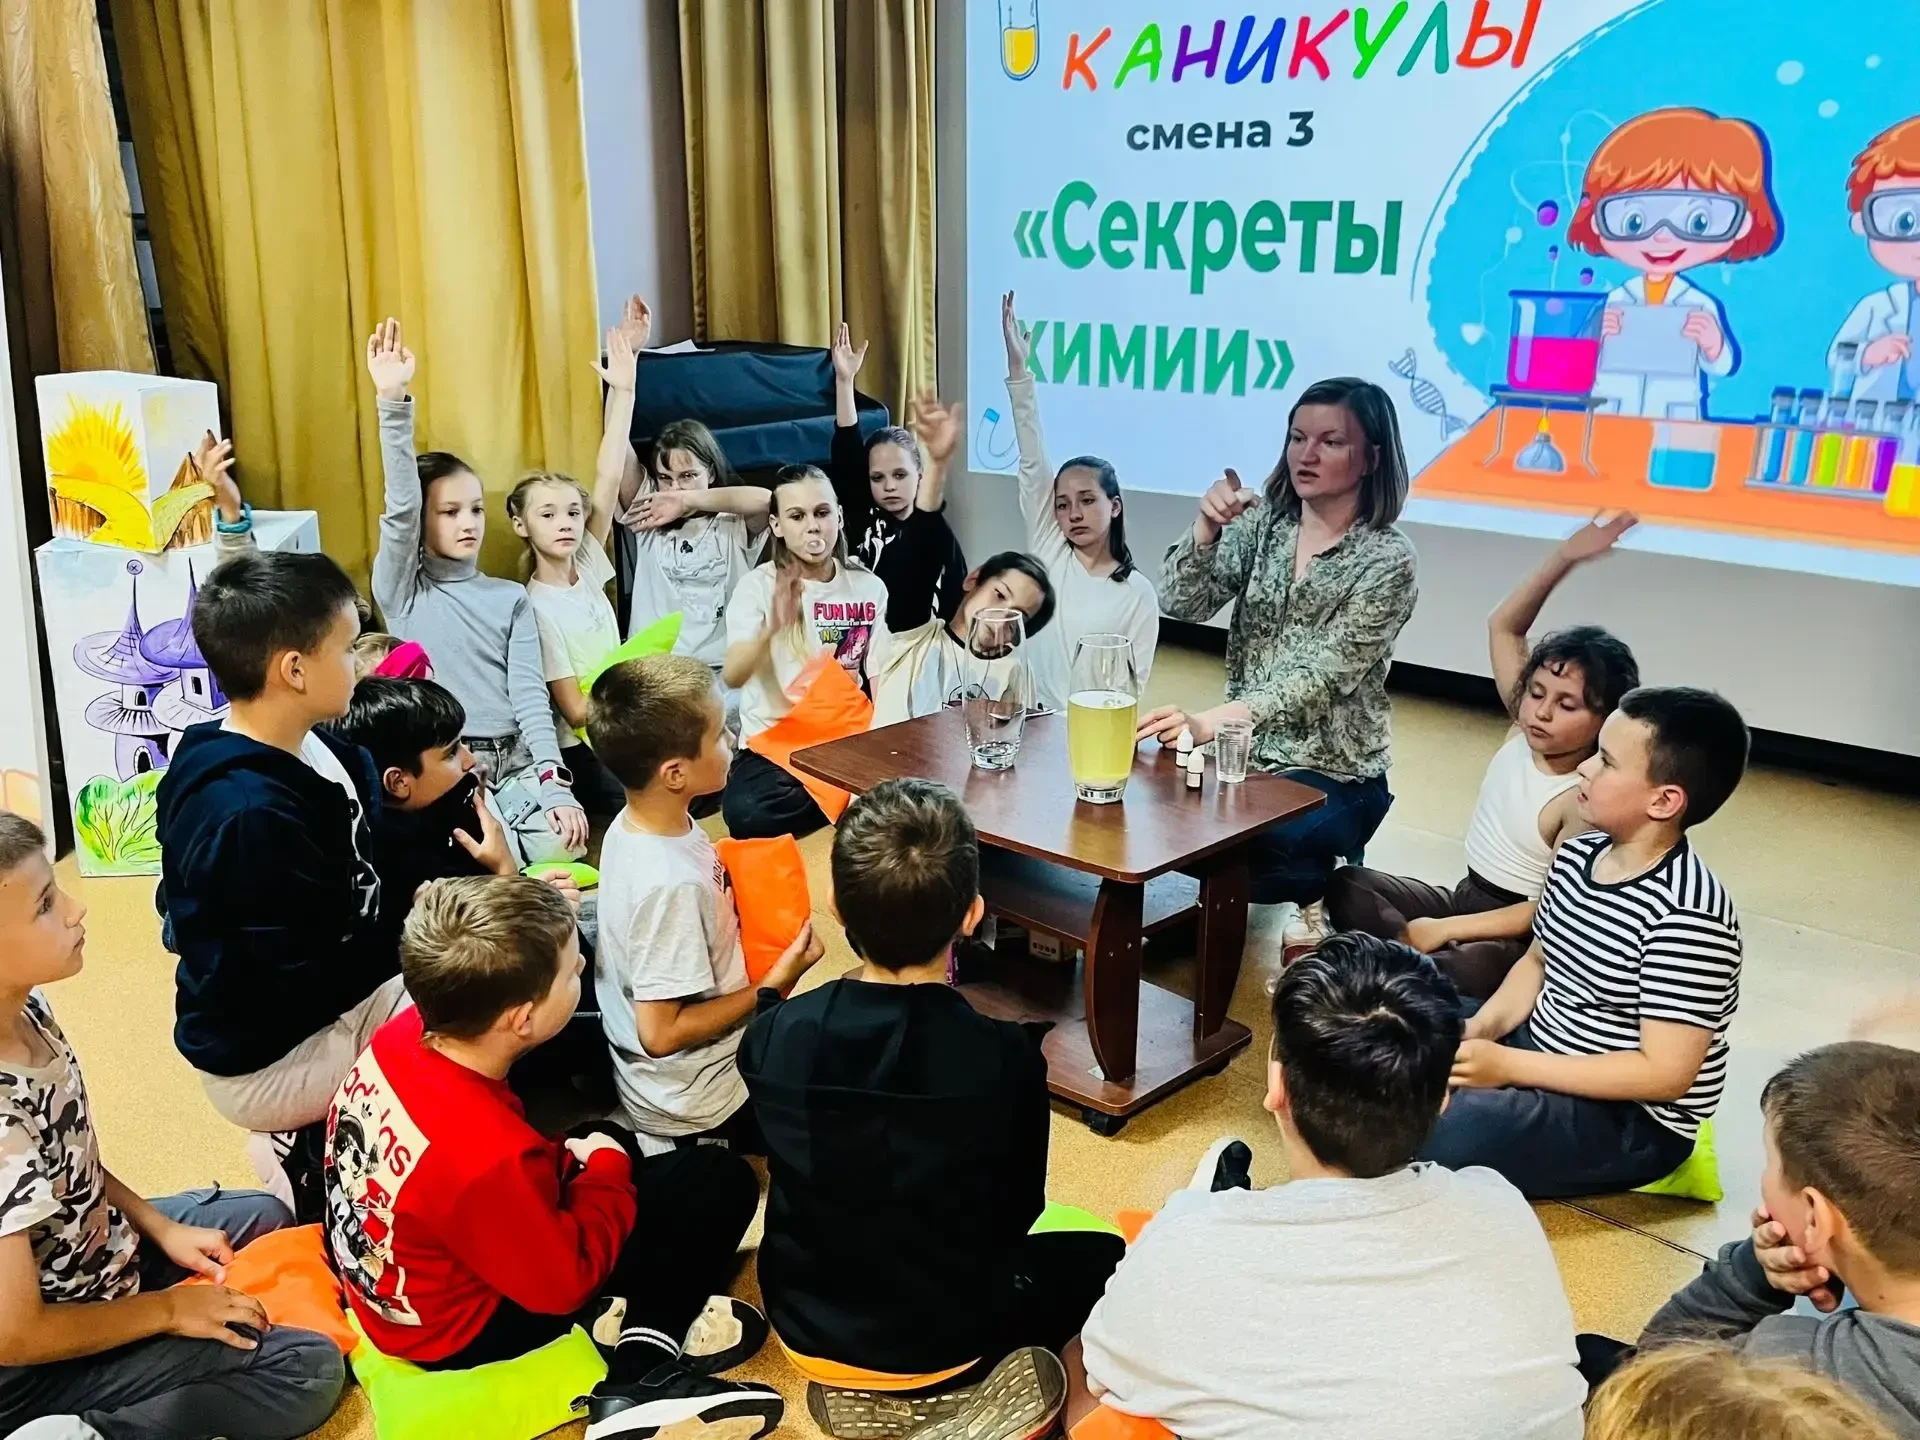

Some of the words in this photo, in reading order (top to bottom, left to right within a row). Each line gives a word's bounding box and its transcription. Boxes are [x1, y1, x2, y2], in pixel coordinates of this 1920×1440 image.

[1062, 0, 1542, 92] КАНИКУЛЫ
[1126, 117, 1272, 151] смена
[1286, 110, 1315, 148] 3
[1013, 180, 1403, 295] «Секреты
[814, 602, 844, 621] FUN
[846, 601, 876, 622] MAG
